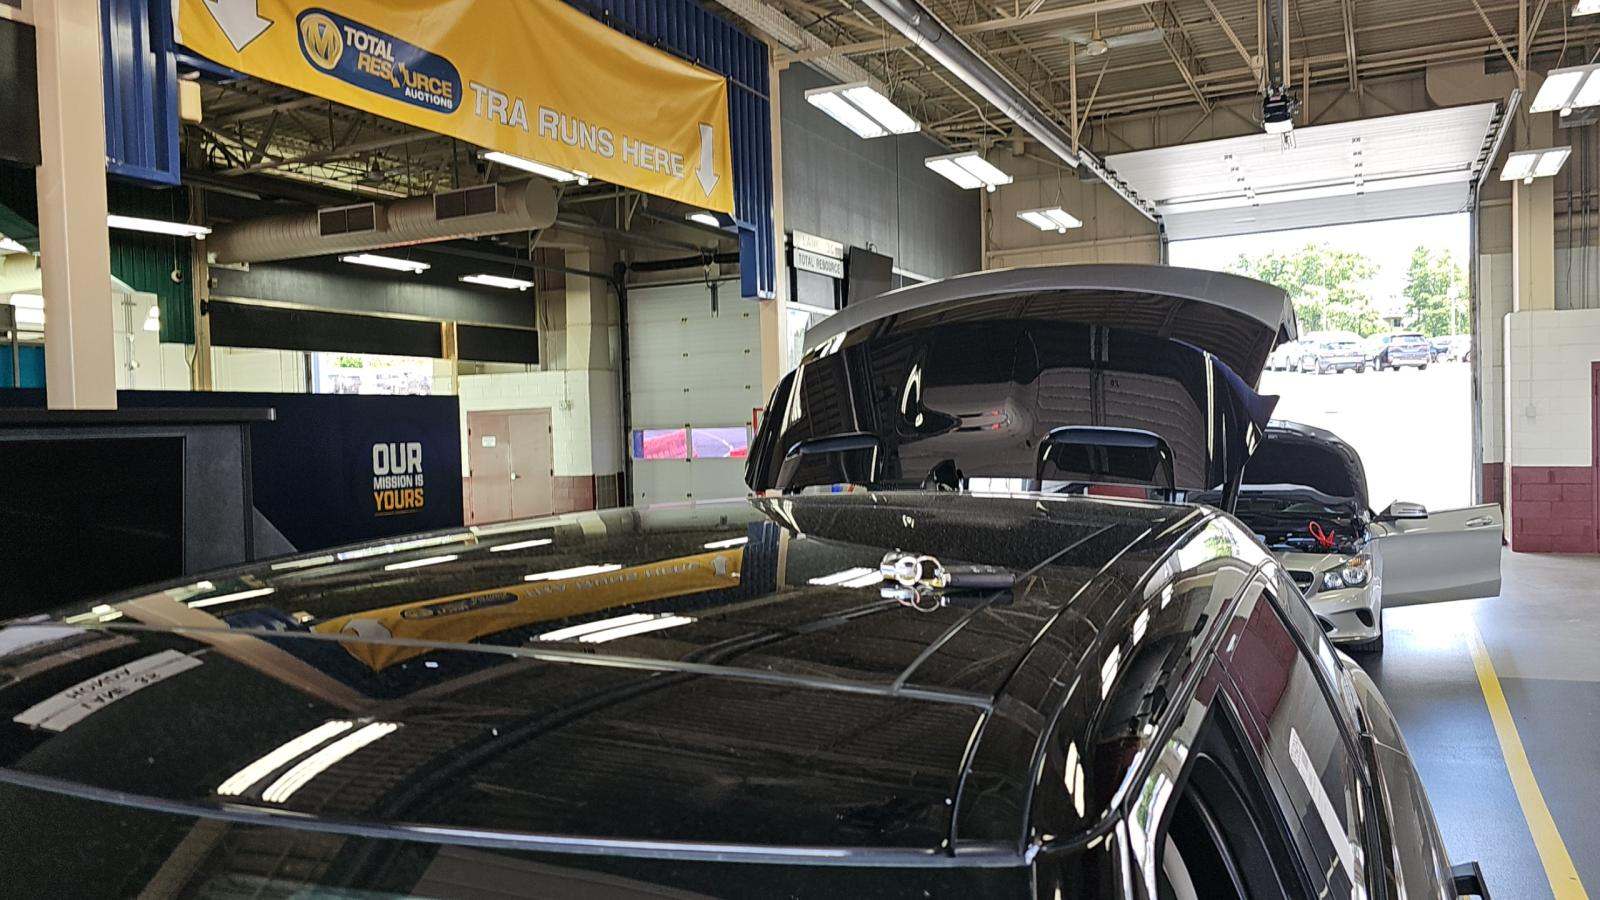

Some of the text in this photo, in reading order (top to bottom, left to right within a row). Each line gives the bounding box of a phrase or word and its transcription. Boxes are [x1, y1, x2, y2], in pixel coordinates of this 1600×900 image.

[344, 25, 395, 62] TOTAL
[405, 86, 453, 110] AUCTIONS
[469, 80, 685, 180] TRA RUNS HERE
[798, 251, 815, 268] TOTAL
[372, 442, 422, 475] OUR
[373, 473, 424, 490] MISSION IS
[373, 488, 424, 511] YOURS
